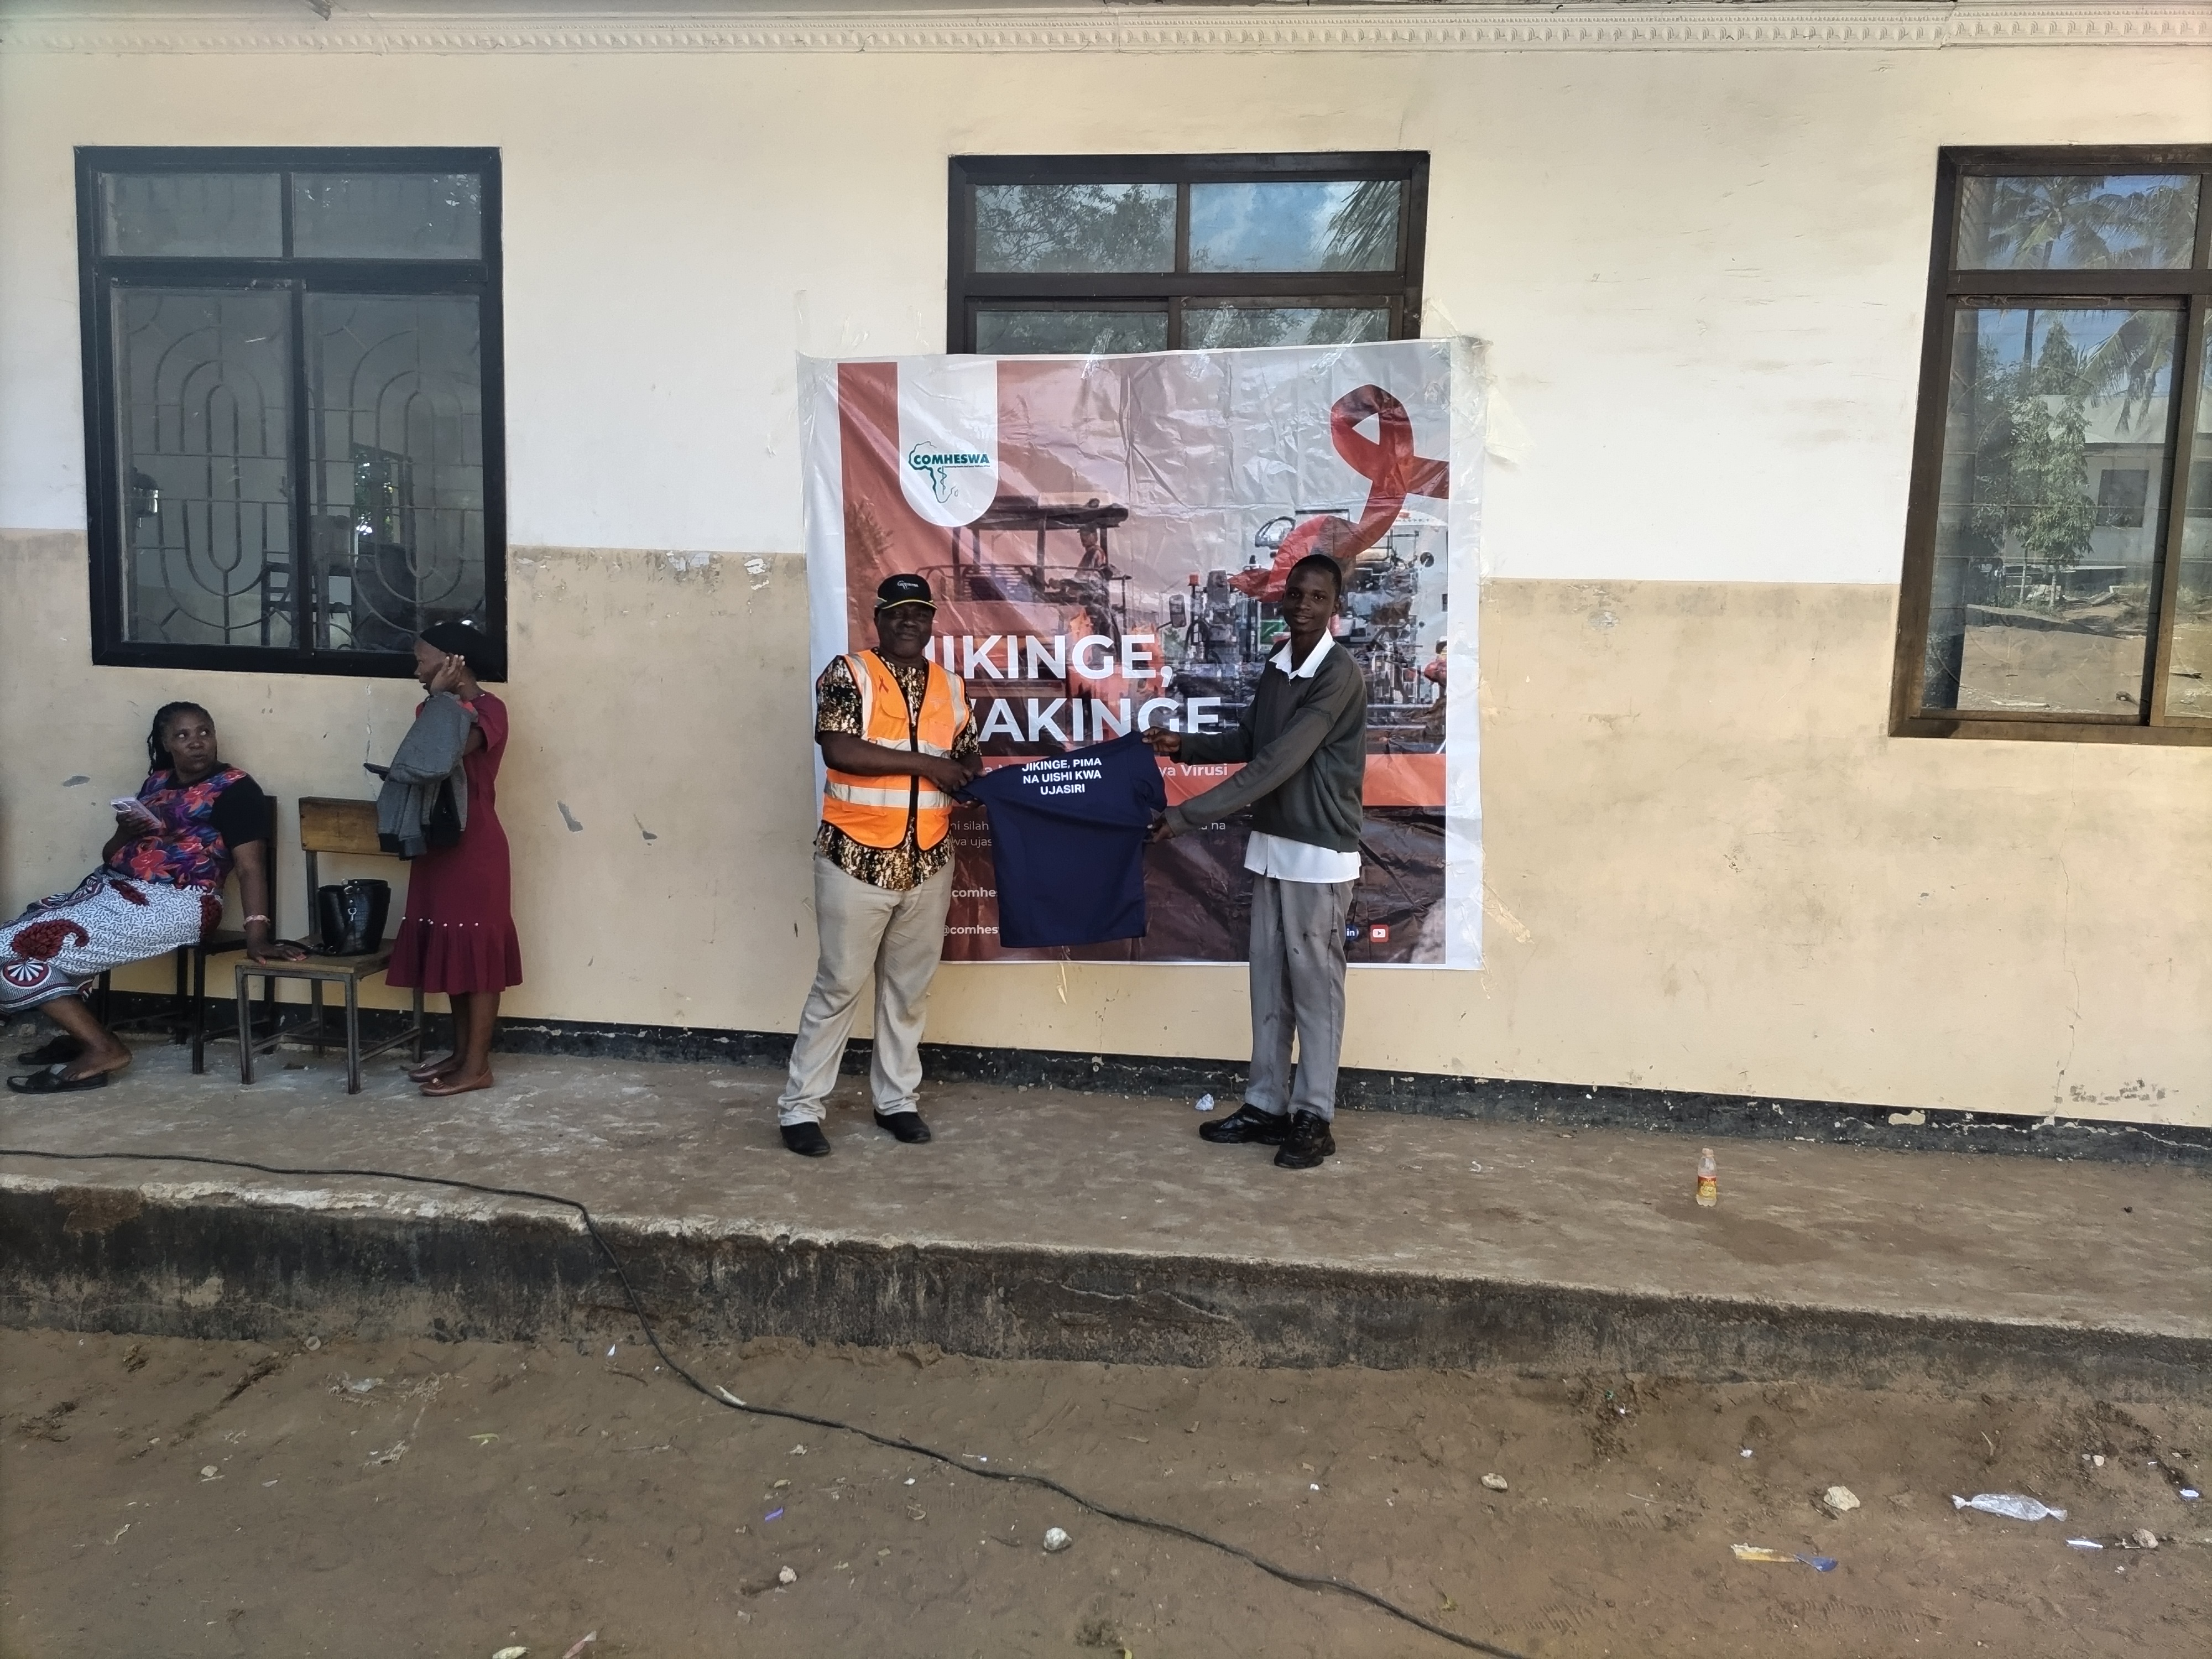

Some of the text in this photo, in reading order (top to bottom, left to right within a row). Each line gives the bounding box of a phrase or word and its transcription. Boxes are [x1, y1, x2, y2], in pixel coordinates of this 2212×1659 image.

[914, 454, 990, 465] COMHESWA
[971, 697, 1222, 742] AKINGE
[1022, 758, 1102, 771] JIKINGE, PIMA
[1181, 763, 1228, 776] Virusi
[1023, 770, 1102, 784] NA UISHI KWA
[1040, 783, 1085, 795] UJASIRI
[952, 887, 998, 897] comhe
